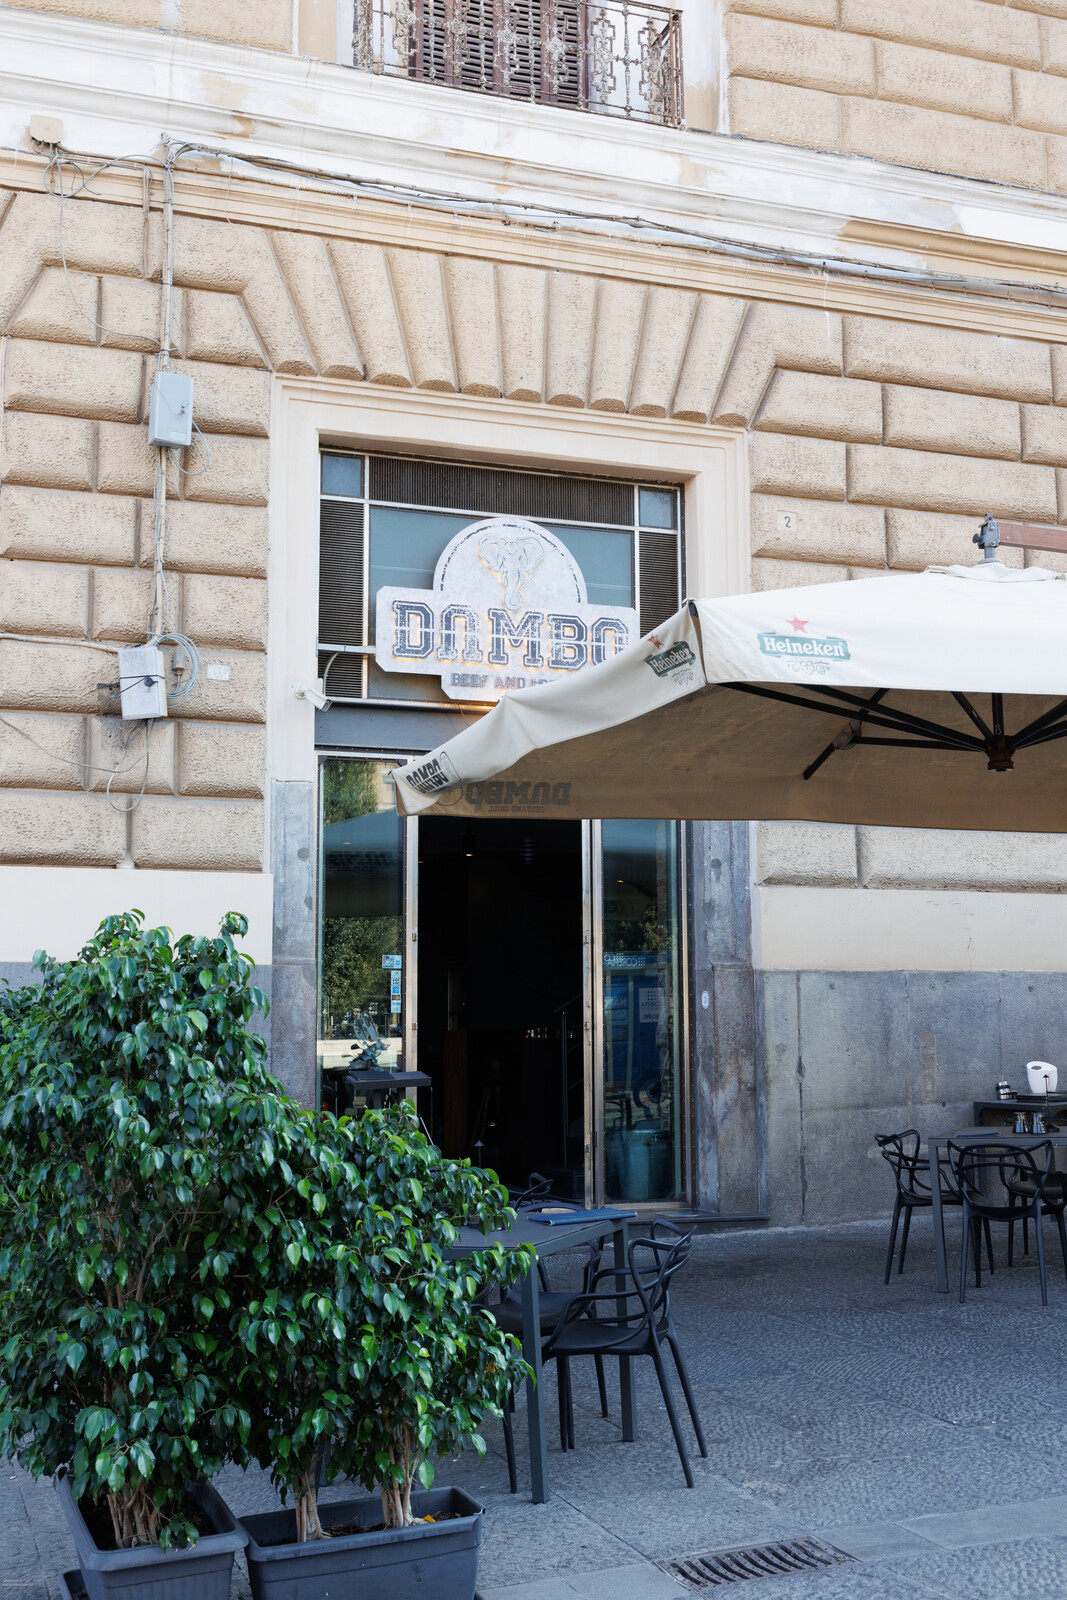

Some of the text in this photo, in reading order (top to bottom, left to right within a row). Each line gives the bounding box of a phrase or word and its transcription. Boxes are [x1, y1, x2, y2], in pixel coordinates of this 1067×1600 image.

[784, 516, 791, 528] 2
[763, 637, 845, 657] Heineken
[652, 648, 691, 672] Heineken
[451, 672, 488, 688] BEEF
[494, 676, 526, 690] AND
